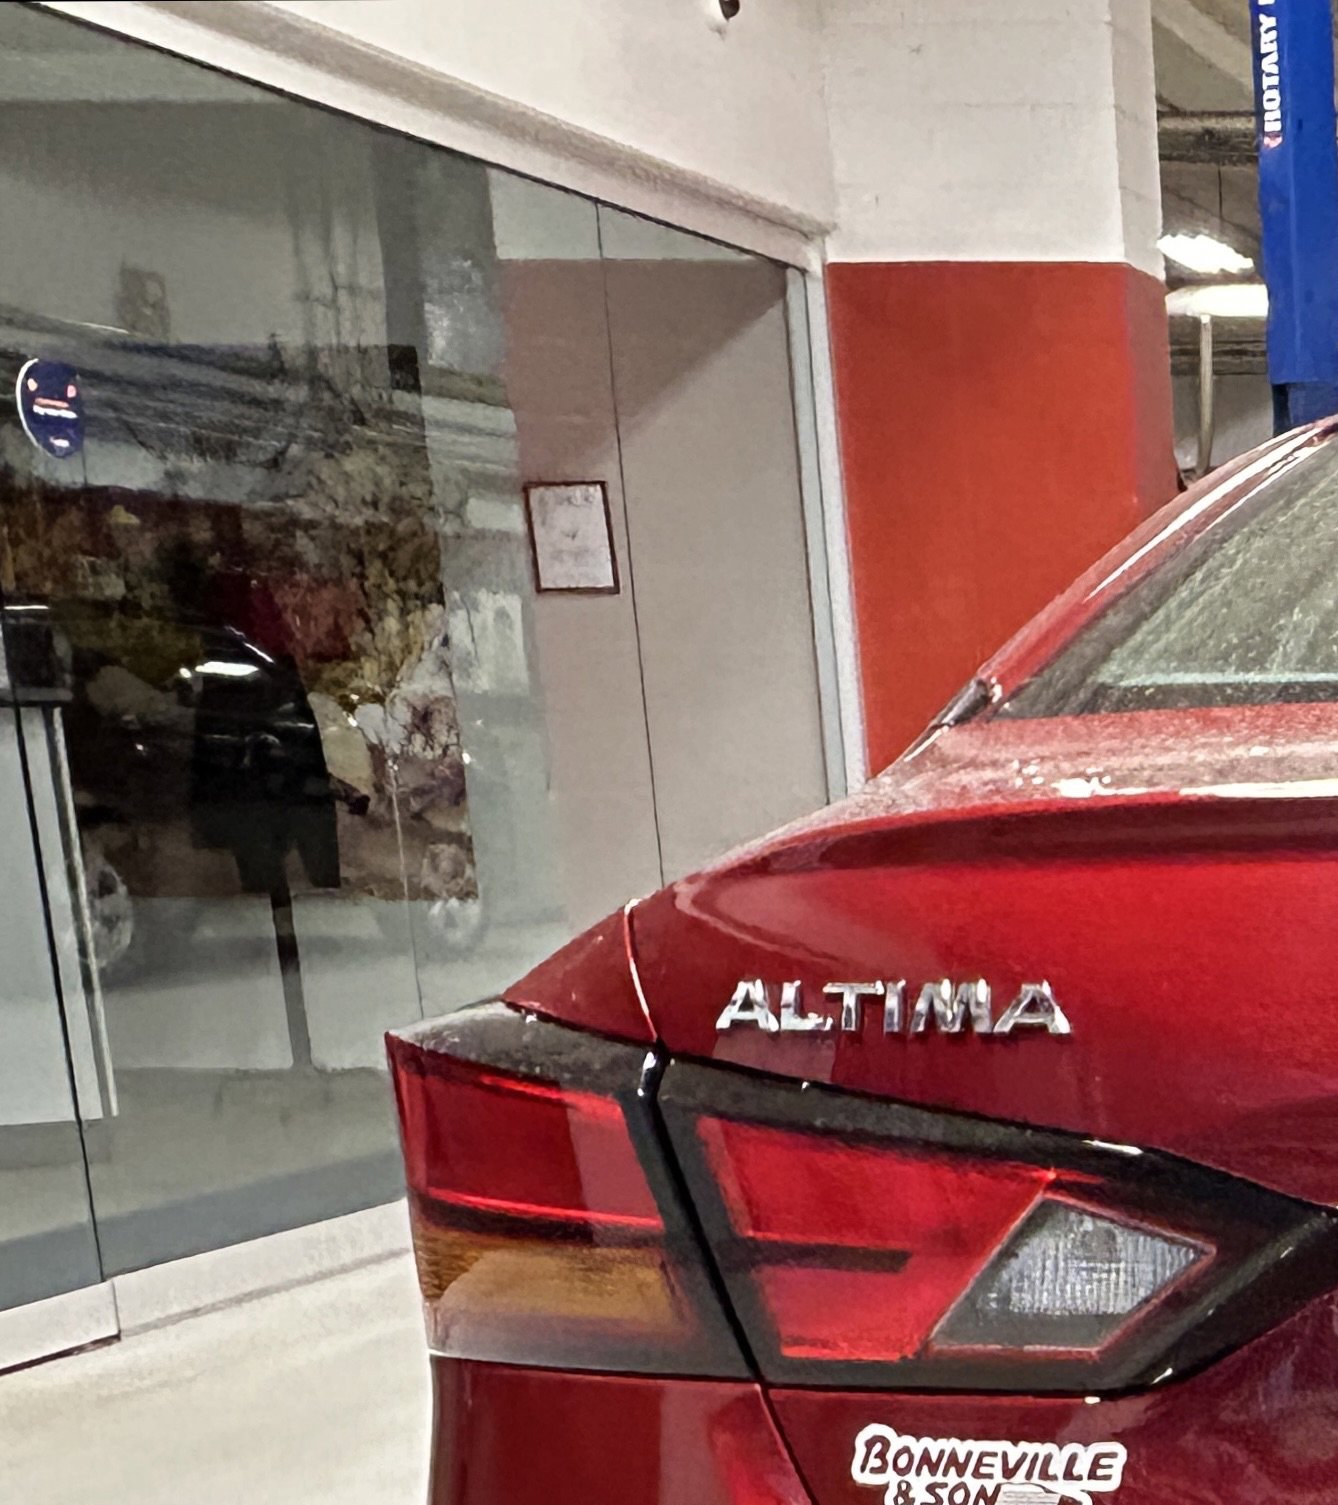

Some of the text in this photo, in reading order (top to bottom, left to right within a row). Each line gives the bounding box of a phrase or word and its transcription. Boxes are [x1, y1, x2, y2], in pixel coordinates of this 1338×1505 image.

[1258, 12, 1282, 132] ROTARY
[715, 979, 1072, 1034] ALTIMA
[858, 1433, 1120, 1483] BONNEVILLE
